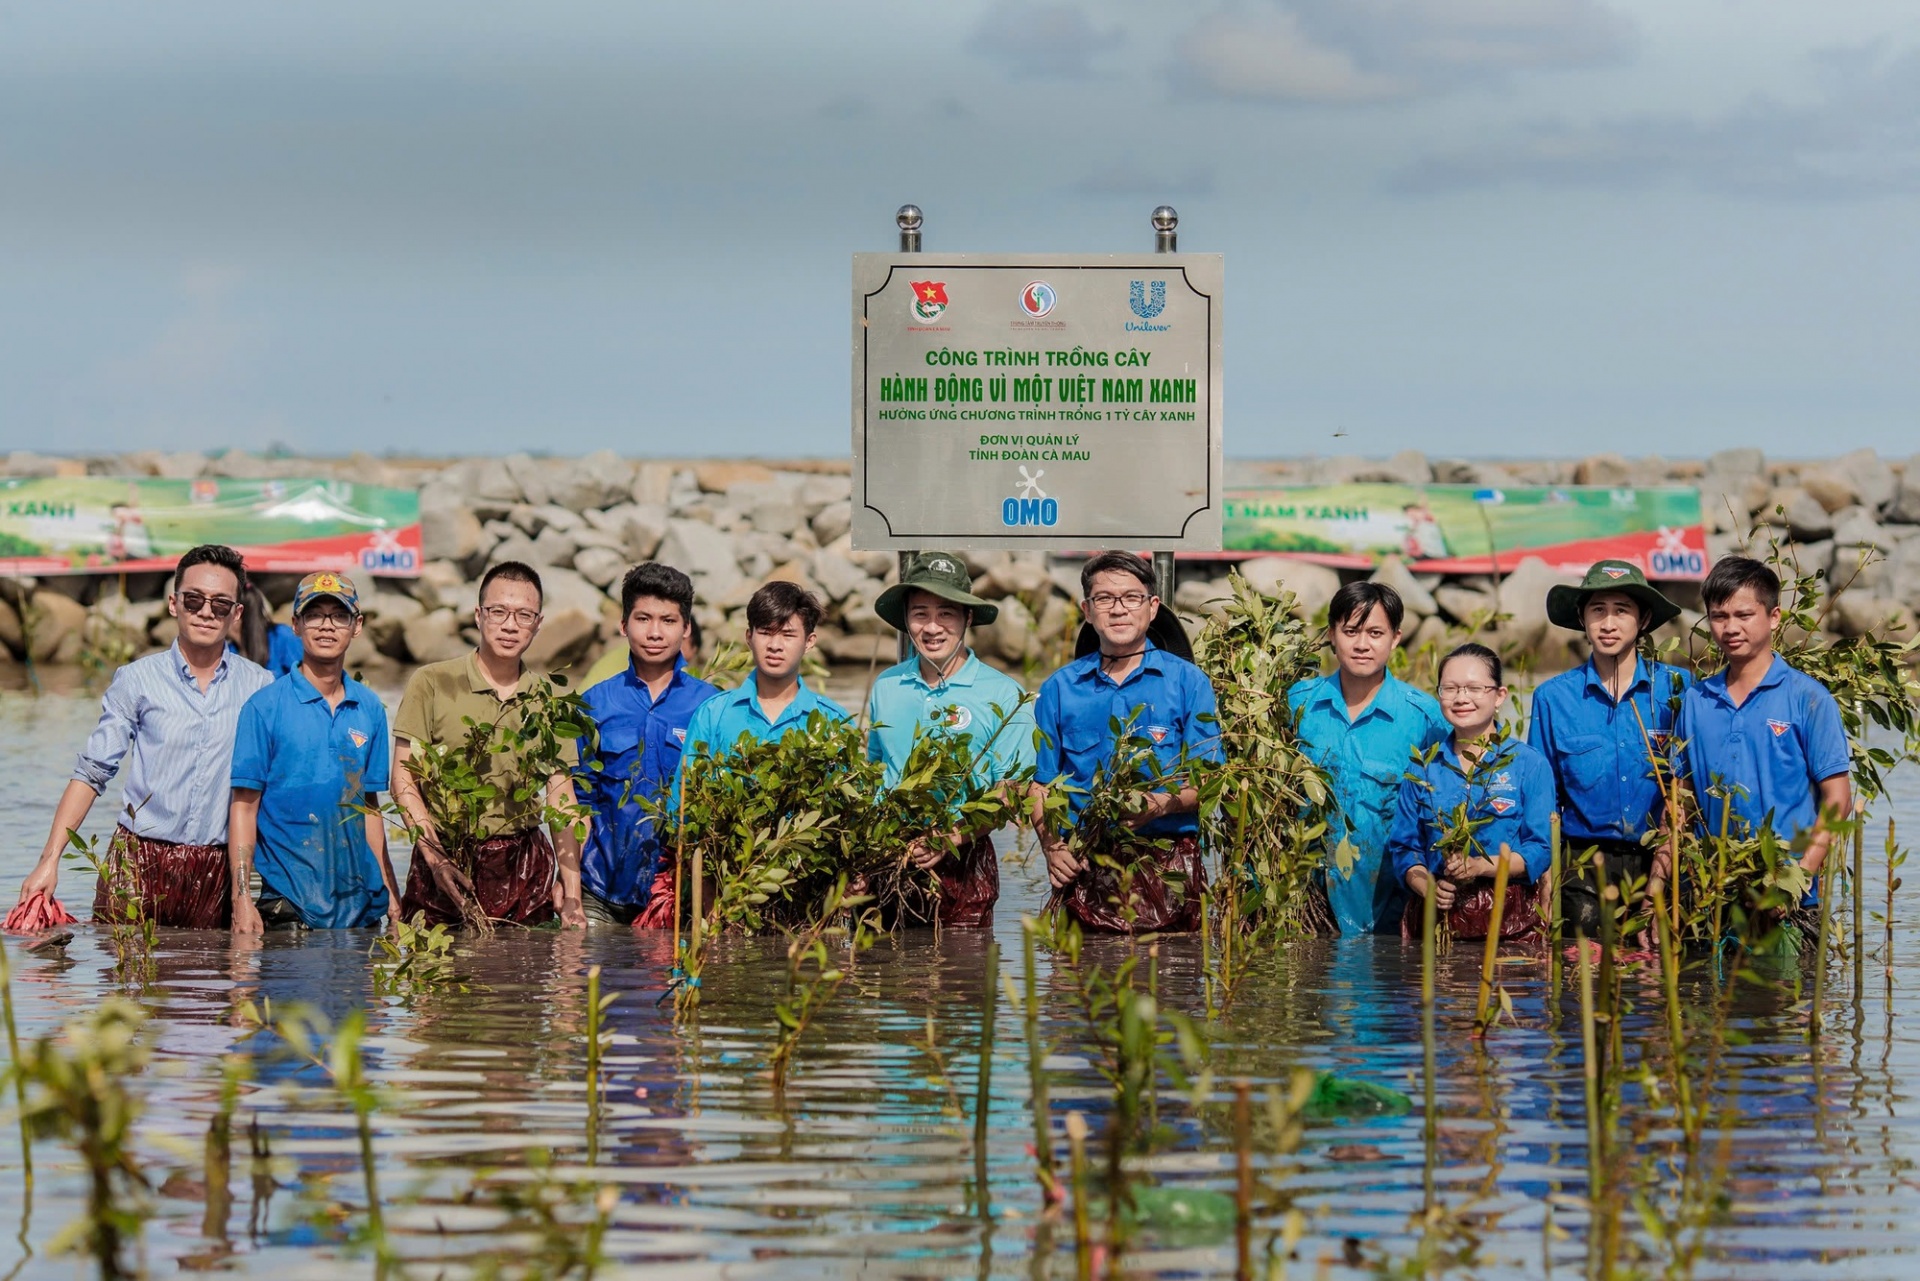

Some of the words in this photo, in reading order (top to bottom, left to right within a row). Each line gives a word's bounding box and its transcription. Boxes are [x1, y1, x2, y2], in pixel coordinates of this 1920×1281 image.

[1125, 321, 1171, 331] Unilever
[925, 347, 978, 366] CÔNG
[983, 347, 1039, 366] TRÌNH
[1045, 345, 1109, 367] TRỒNG
[1114, 347, 1151, 367] CÂY
[880, 372, 928, 402] HÀNH
[934, 373, 983, 407] ĐỘNG
[989, 373, 1006, 402] VÌ
[1013, 374, 1052, 407] MỘT
[1058, 374, 1096, 407] VIỆT
[1102, 378, 1143, 403] NAM
[1149, 378, 1197, 403] XANH
[929, 408, 957, 420] ỨNG
[960, 409, 1016, 420] CHƯƠNG
[1018, 408, 1056, 420] TRÌNH
[1106, 411, 1111, 421] 1
[1133, 410, 1157, 421] CÂY
[1160, 411, 1195, 421] XANH
[980, 434, 1008, 445] ĐƠN
[1011, 435, 1023, 448] VỊ
[1026, 432, 1062, 446] QUẢN
[1066, 433, 1080, 445] LÝ
[969, 447, 998, 460] TỈNH
[1001, 448, 1039, 460] ĐOÀN
[1042, 448, 1058, 460] CÀ
[1062, 450, 1090, 461] MAU
[7, 500, 75, 519] XANH
[1002, 497, 1059, 527] OMO
[1244, 505, 1296, 518] NAM
[1304, 505, 1369, 520] XANH
[362, 550, 414, 570] OMO
[1652, 552, 1702, 574] OMO
